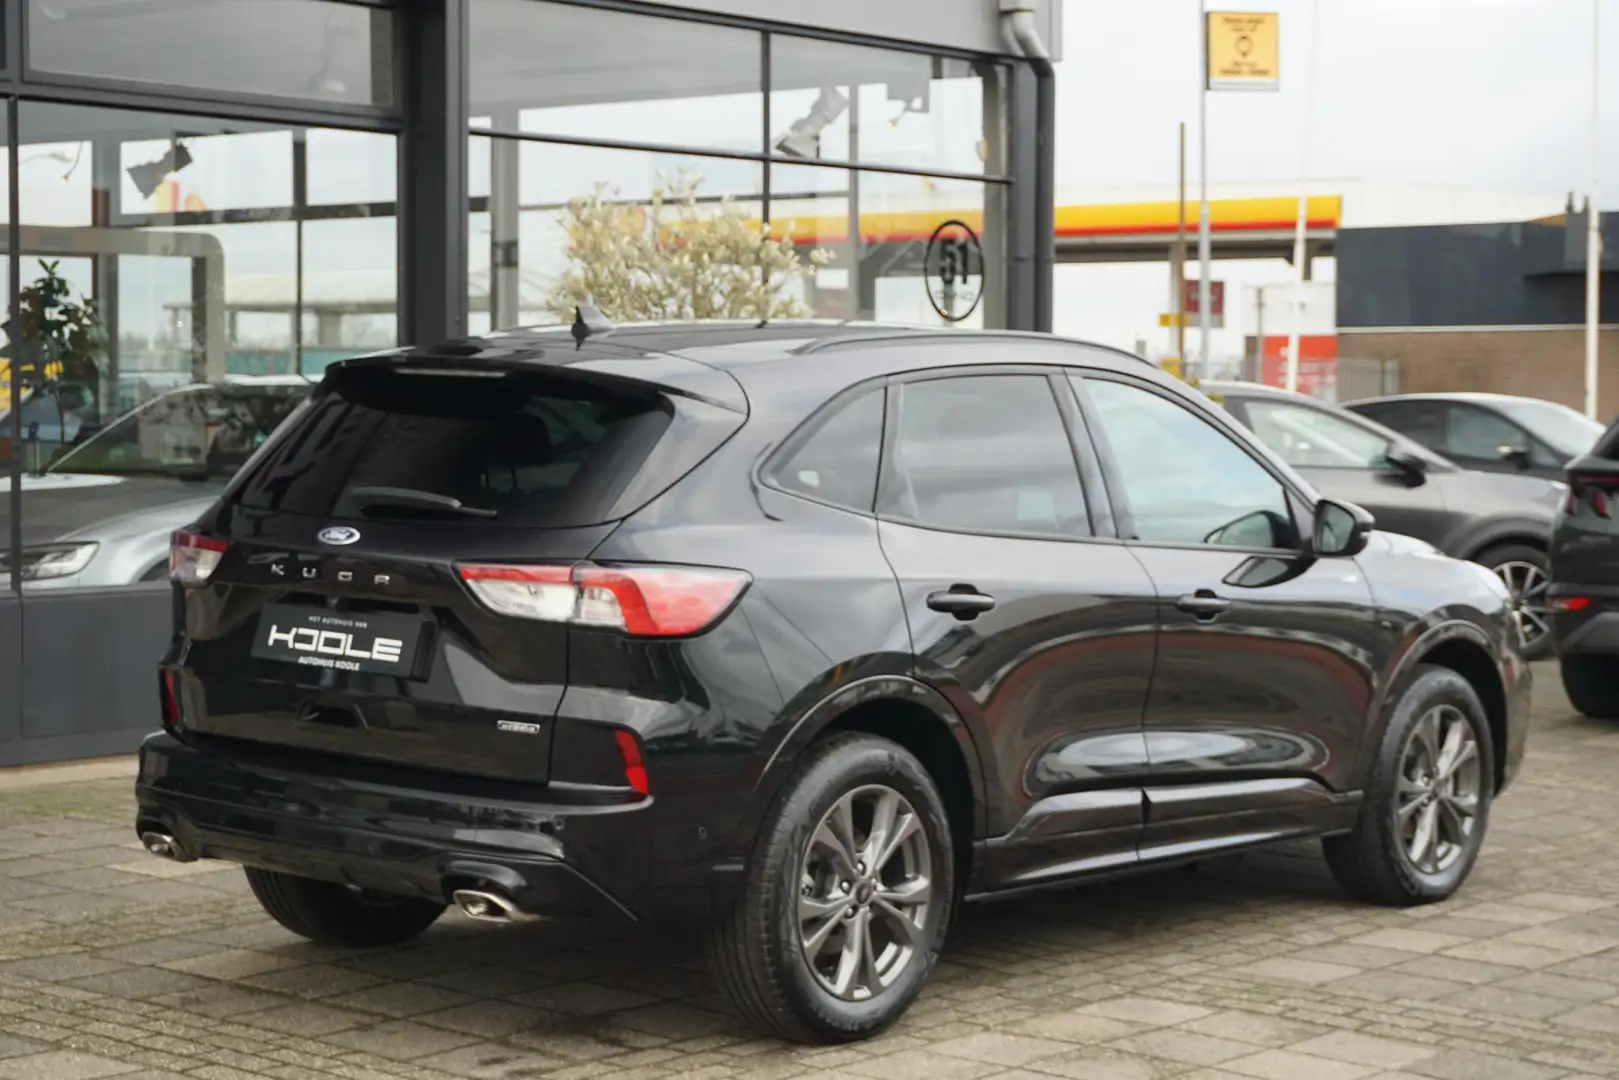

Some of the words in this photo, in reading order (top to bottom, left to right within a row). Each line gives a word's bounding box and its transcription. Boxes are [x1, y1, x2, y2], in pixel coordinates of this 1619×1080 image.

[940, 239, 968, 285] 51
[267, 624, 403, 662] KOOLE
[298, 656, 334, 668] AUTOHUIS
[334, 660, 360, 671] KOOLE
